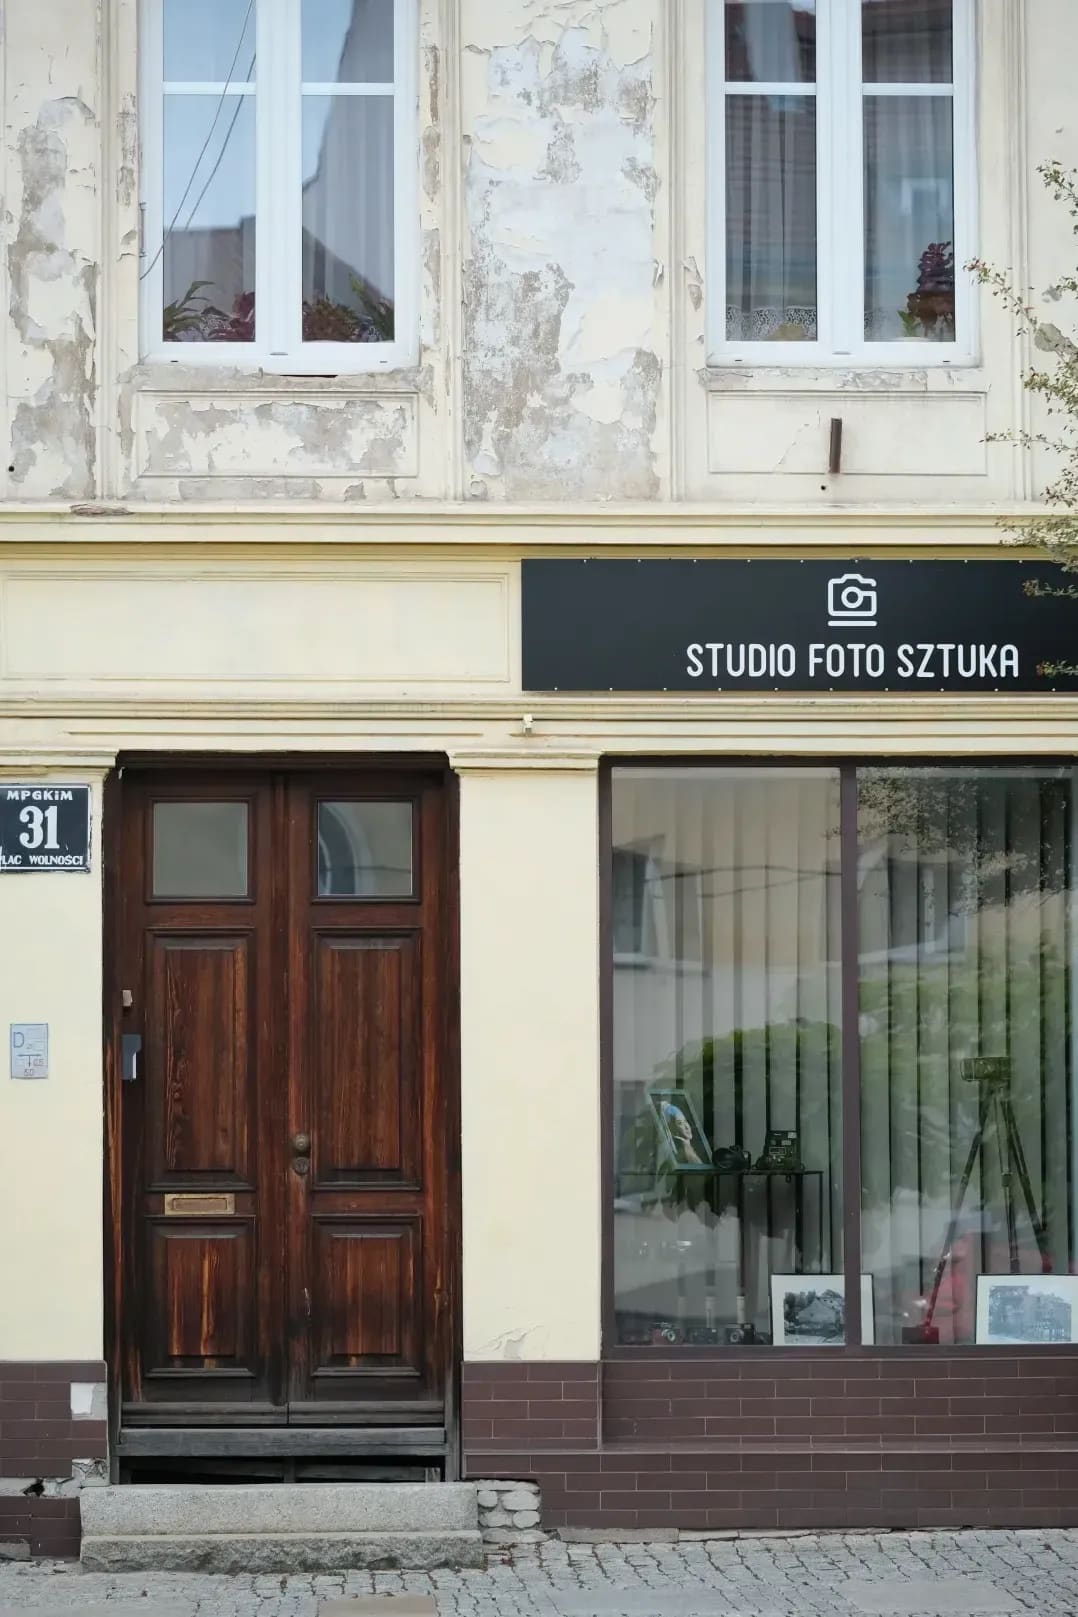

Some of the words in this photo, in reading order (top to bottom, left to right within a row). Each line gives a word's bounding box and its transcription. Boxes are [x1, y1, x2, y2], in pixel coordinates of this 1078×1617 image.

[686, 643, 795, 677] STUDIO
[809, 643, 884, 677] FOTO
[897, 643, 1019, 677] SZTUKA
[19, 805, 60, 848] 31
[29, 854, 83, 865] WOLNOŚCI
